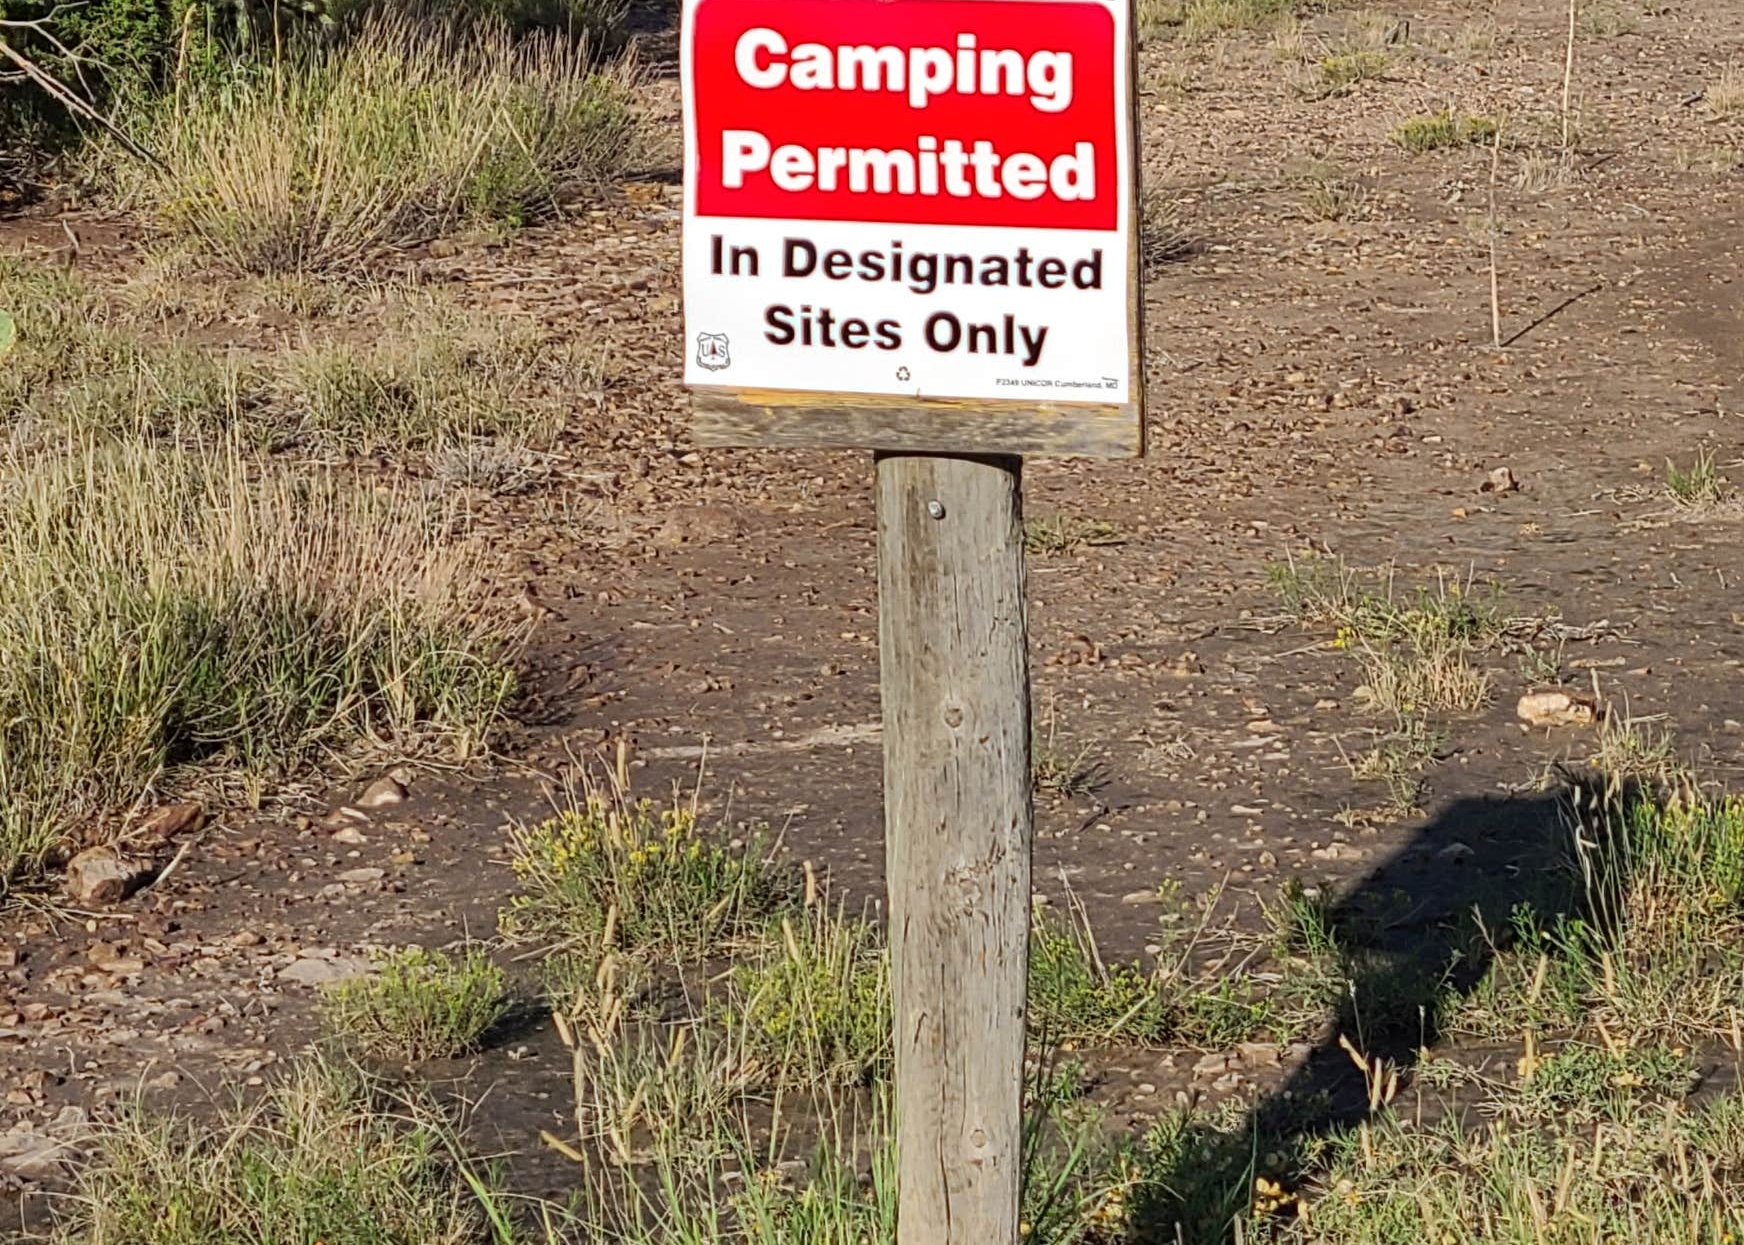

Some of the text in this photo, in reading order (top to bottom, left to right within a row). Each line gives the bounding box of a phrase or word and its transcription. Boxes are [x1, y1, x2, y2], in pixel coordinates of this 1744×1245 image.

[734, 27, 1073, 112] Camping
[721, 129, 1096, 201] Permitted
[710, 234, 1103, 294] In Designated
[764, 304, 1049, 367] Sites Only
[1021, 379, 1053, 387] UNICOR
